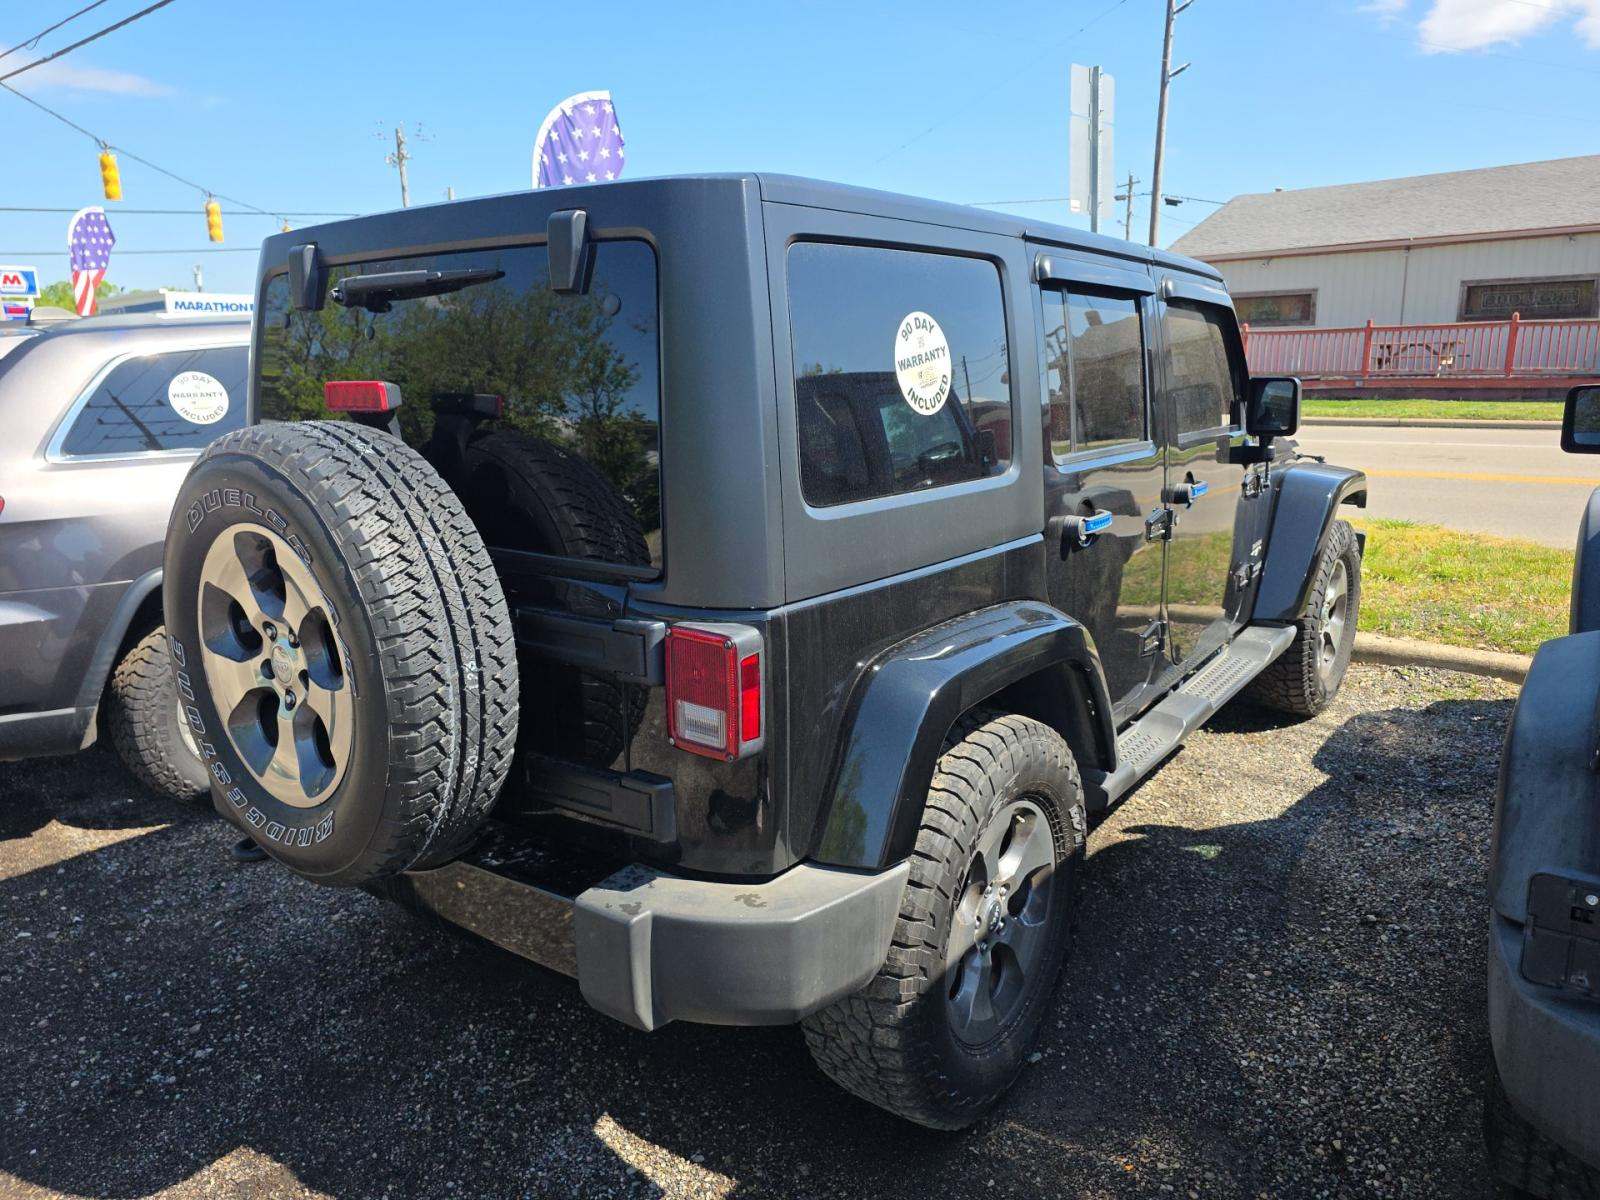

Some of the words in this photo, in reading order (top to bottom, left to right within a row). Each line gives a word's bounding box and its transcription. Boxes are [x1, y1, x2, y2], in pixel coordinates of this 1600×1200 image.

[174, 301, 248, 312] MARATHON
[902, 322, 913, 341] 90
[914, 317, 935, 334] DAY
[898, 346, 946, 372] WARRANTY
[191, 374, 213, 385] DAY
[171, 391, 223, 399] WARRANTY
[907, 374, 948, 410] INCLUDED
[179, 404, 225, 422] INCLUDED
[169, 635, 336, 847] BRIDGESTONE
